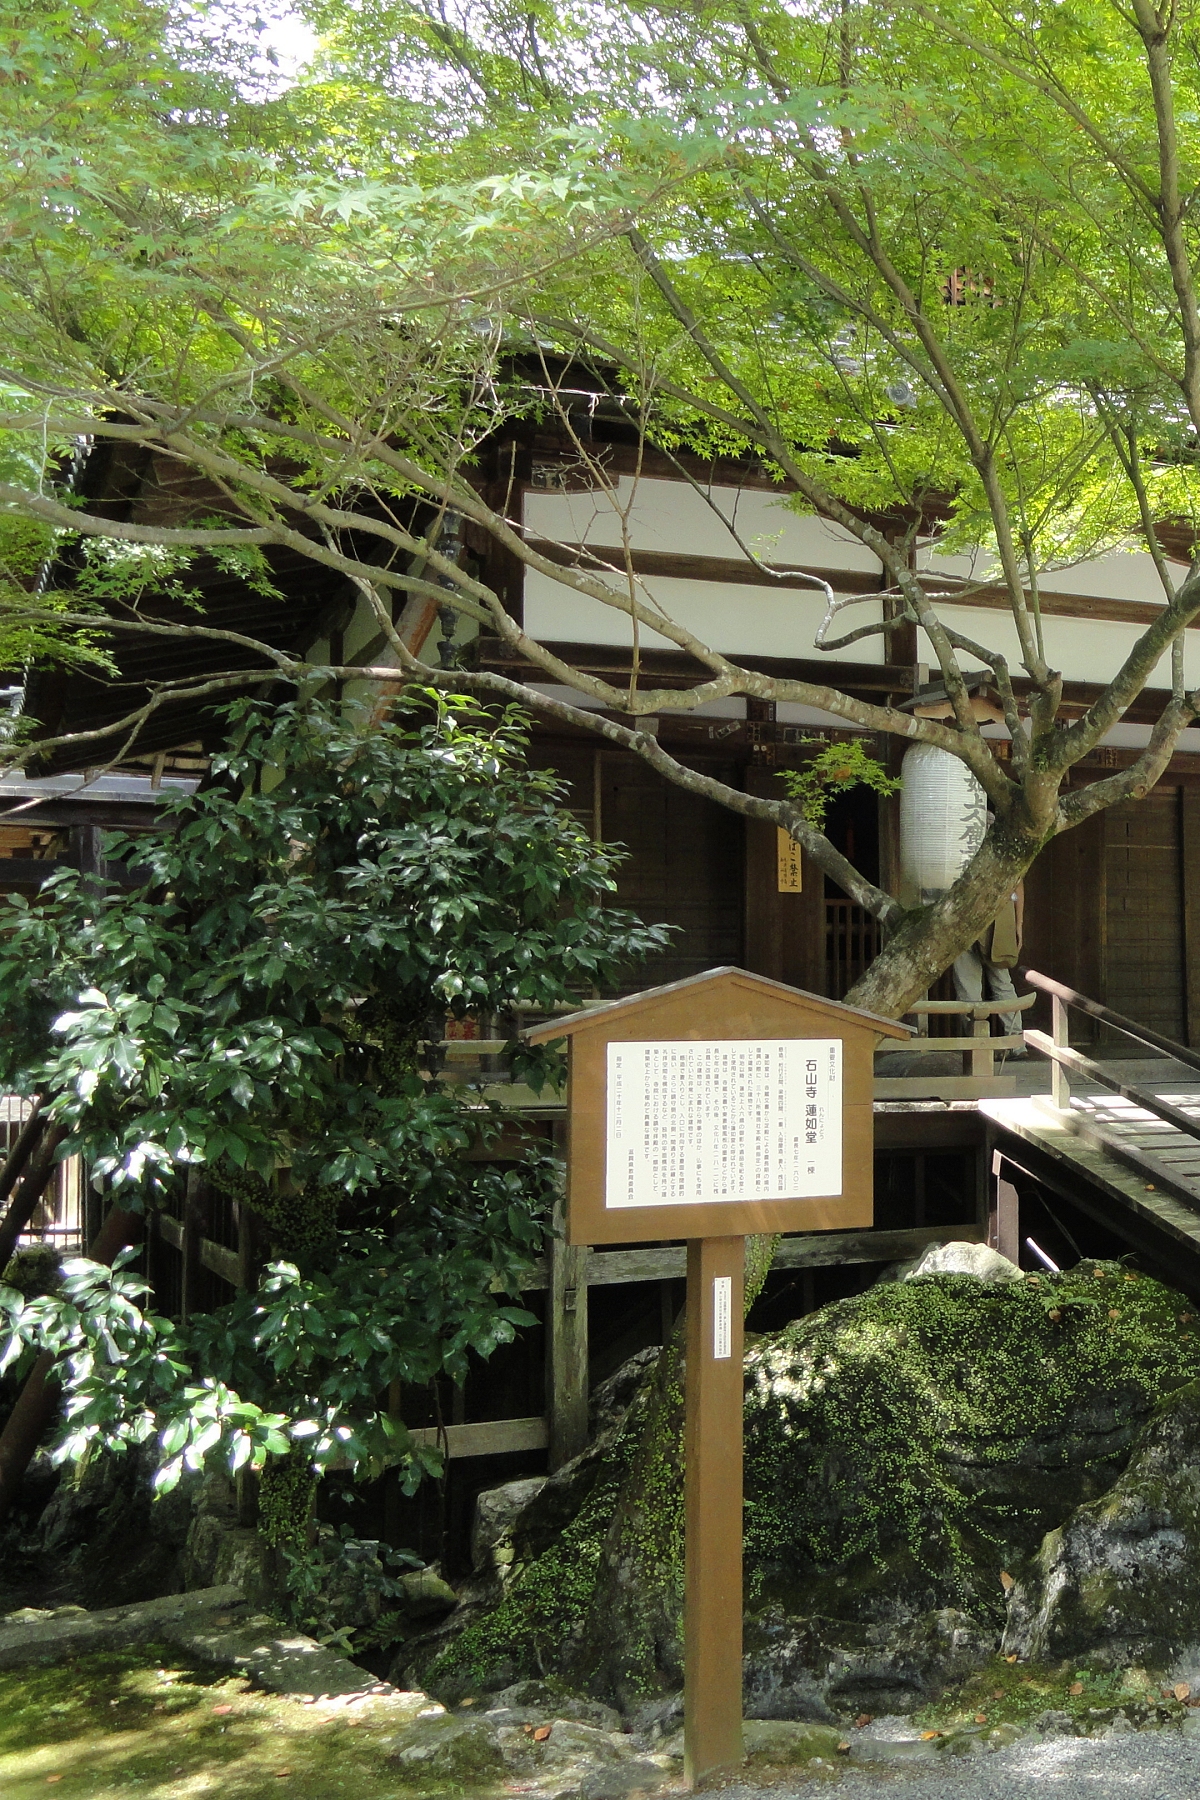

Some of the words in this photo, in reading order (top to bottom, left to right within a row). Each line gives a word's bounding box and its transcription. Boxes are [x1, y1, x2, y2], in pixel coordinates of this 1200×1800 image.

[805, 1059, 817, 1098] 石山寺
[805, 1103, 817, 1143] 蓮如堂
[627, 1148, 635, 1200] 滋賀県教育委員会
[806, 1160, 816, 1174] 一棟
